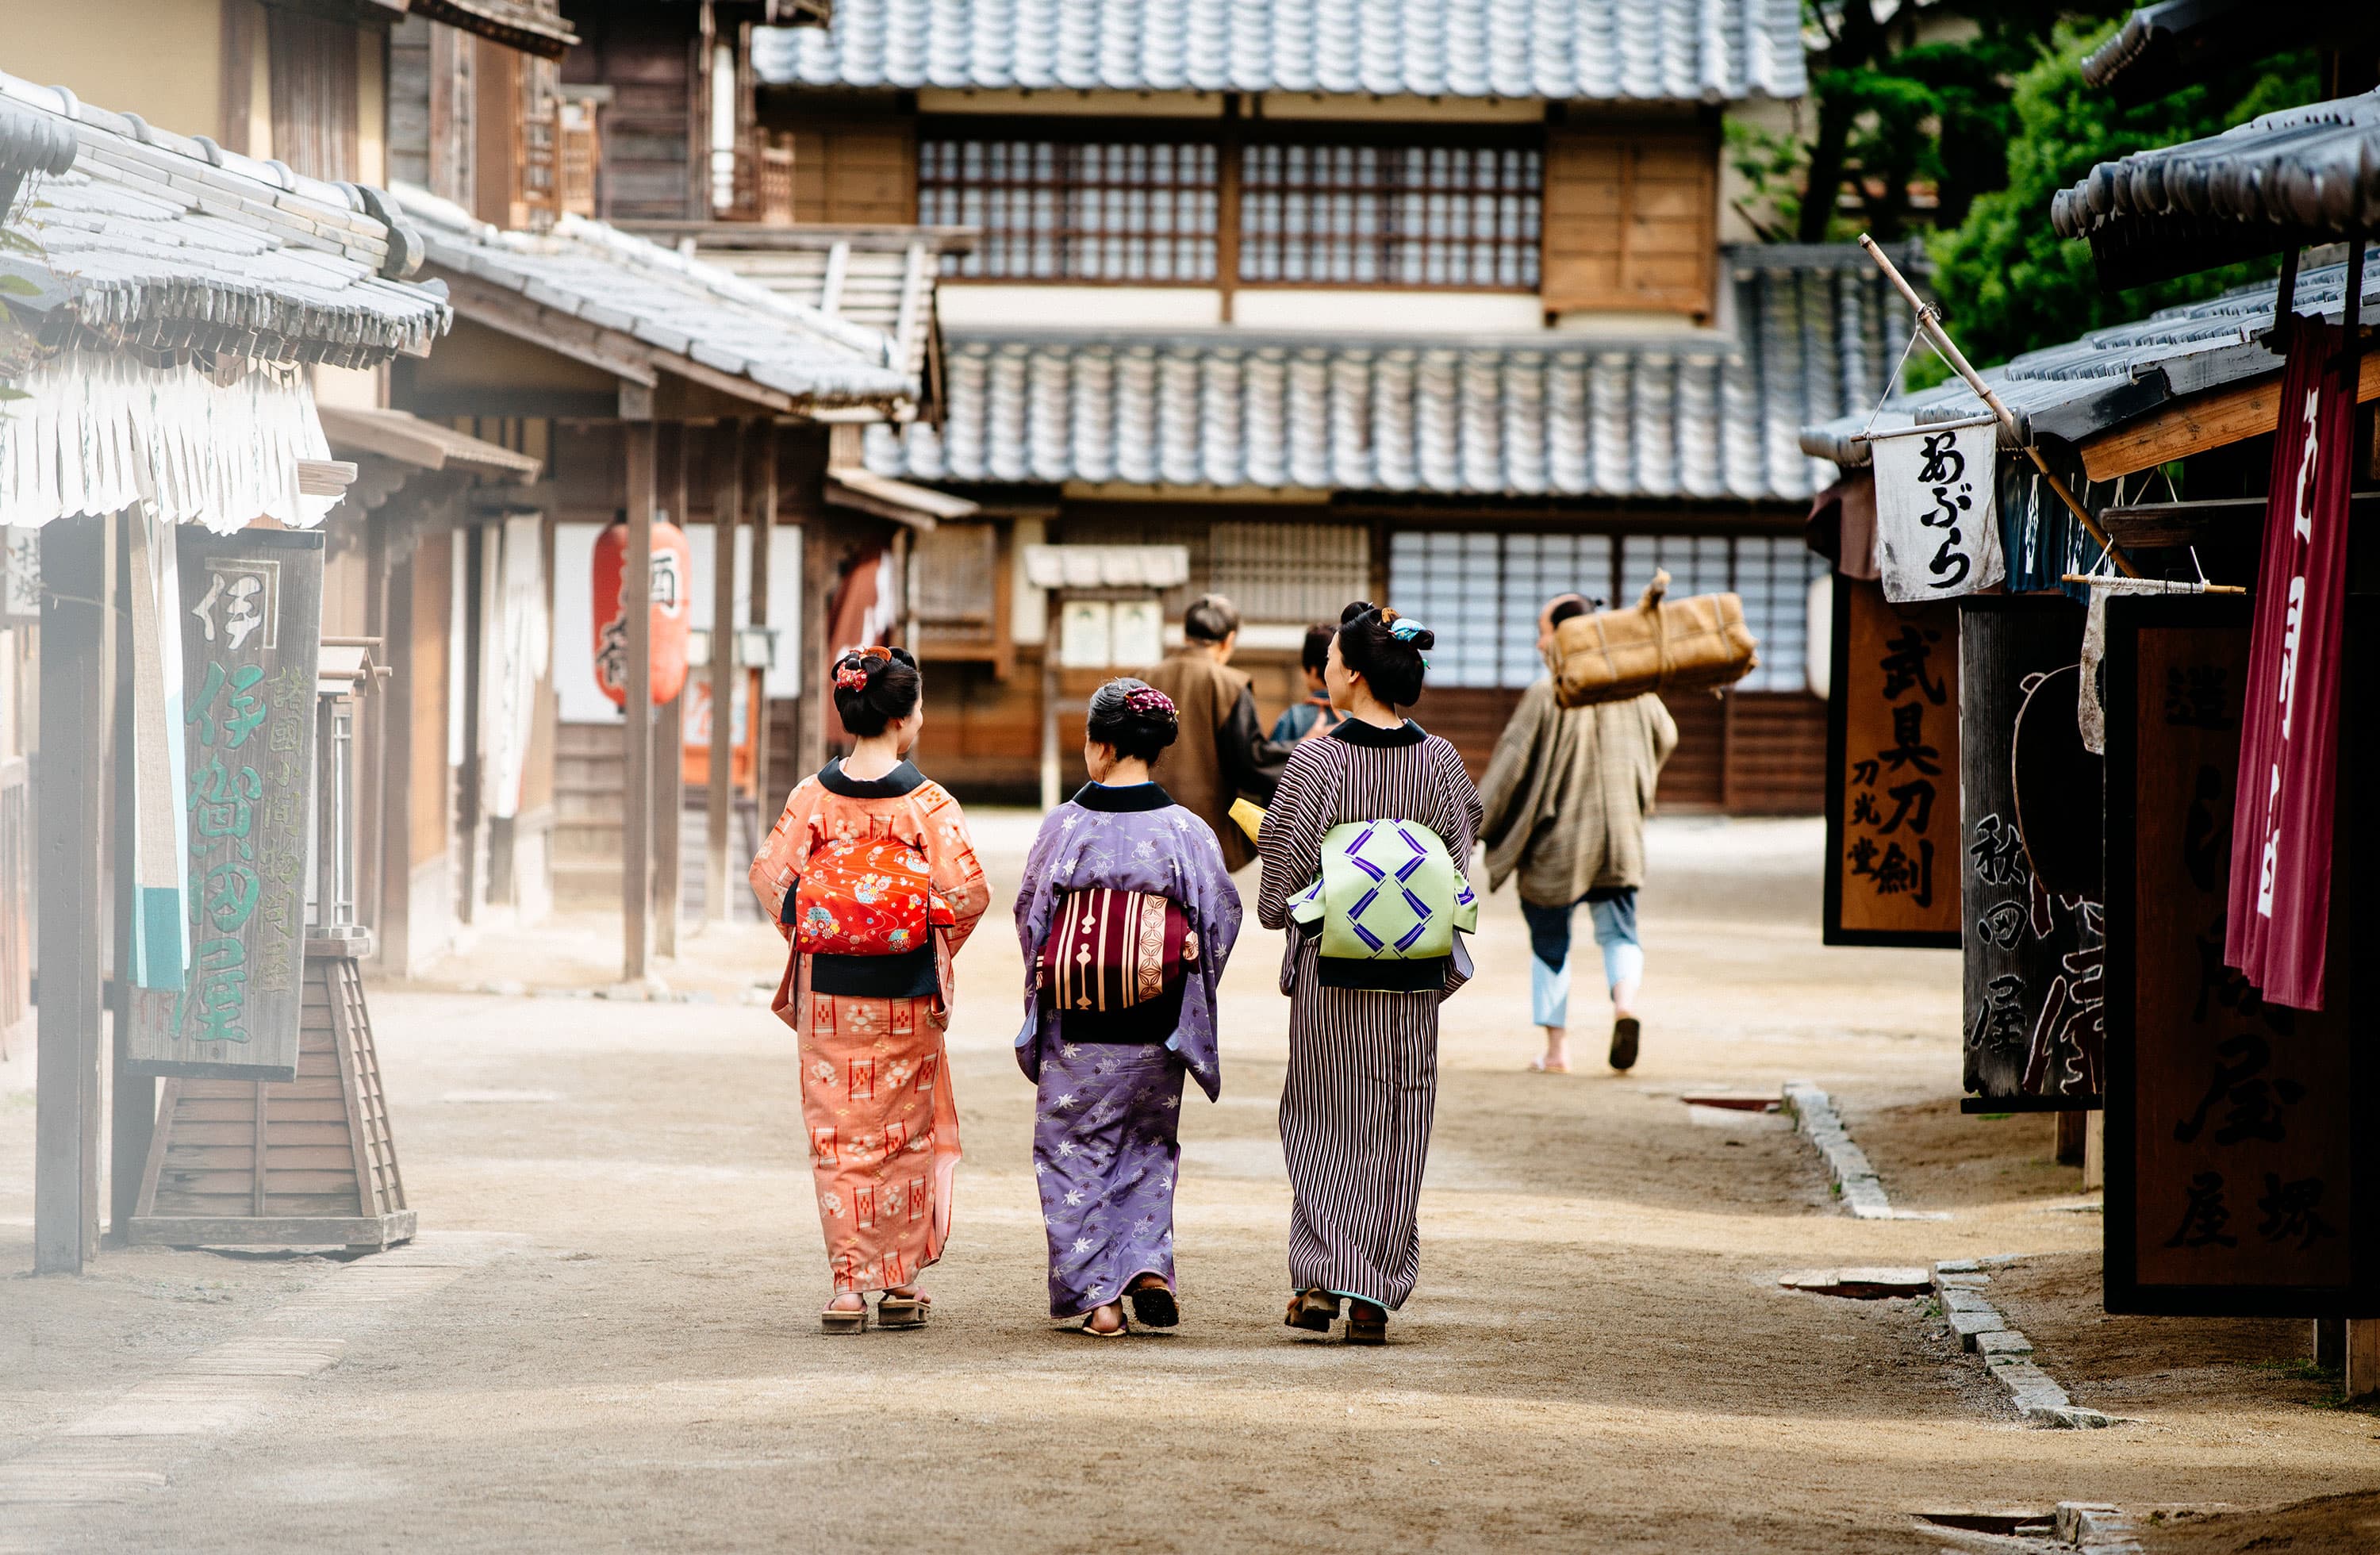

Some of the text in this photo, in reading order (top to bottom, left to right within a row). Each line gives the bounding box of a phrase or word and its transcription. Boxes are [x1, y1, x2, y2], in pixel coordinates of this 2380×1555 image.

[1917, 430, 1972, 589] あぶら
[191, 572, 264, 651] 伊
[1970, 813, 2029, 1057] 秋田屋
